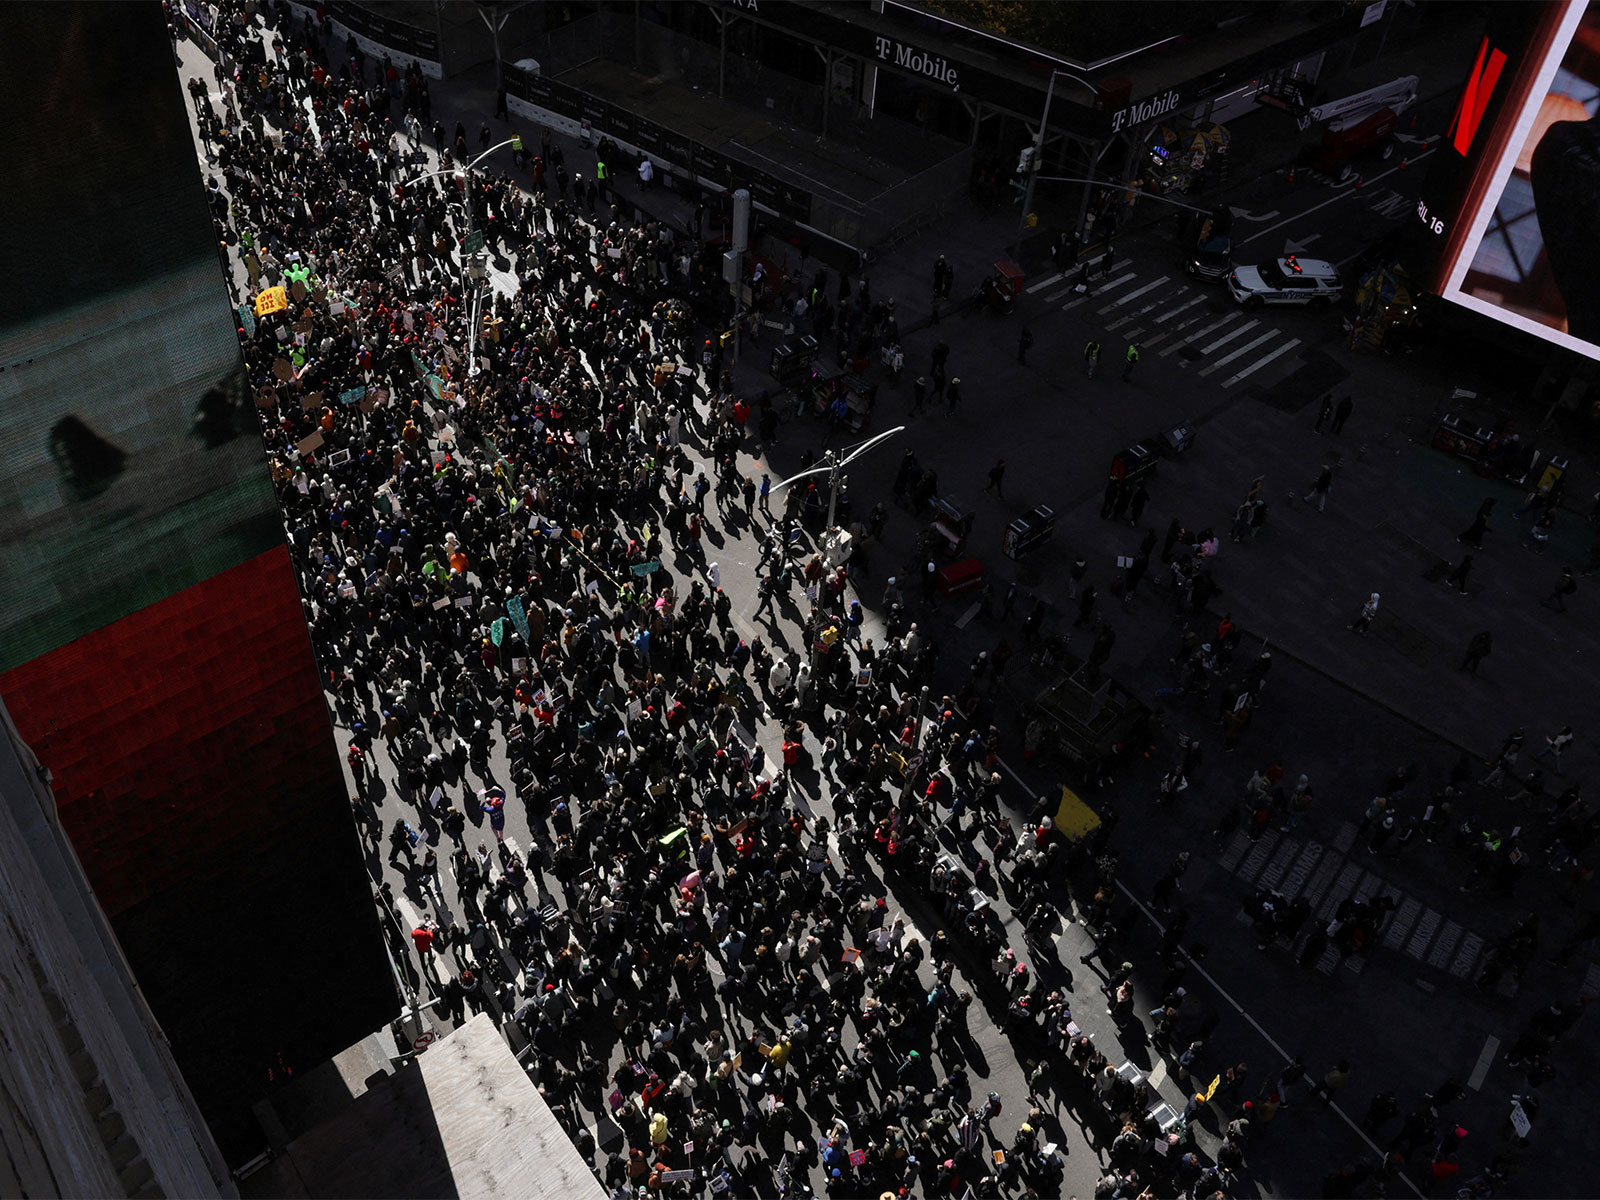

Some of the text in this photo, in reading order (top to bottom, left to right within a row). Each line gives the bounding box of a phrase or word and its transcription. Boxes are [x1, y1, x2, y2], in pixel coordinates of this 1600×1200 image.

[895, 43, 959, 86] Mobile
[1126, 90, 1181, 127] Mobile
[1429, 216, 1445, 235] 16
[1281, 291, 1306, 300] NYPD
[1288, 840, 1324, 886] JAMES
[1453, 931, 1484, 973] SIMON
